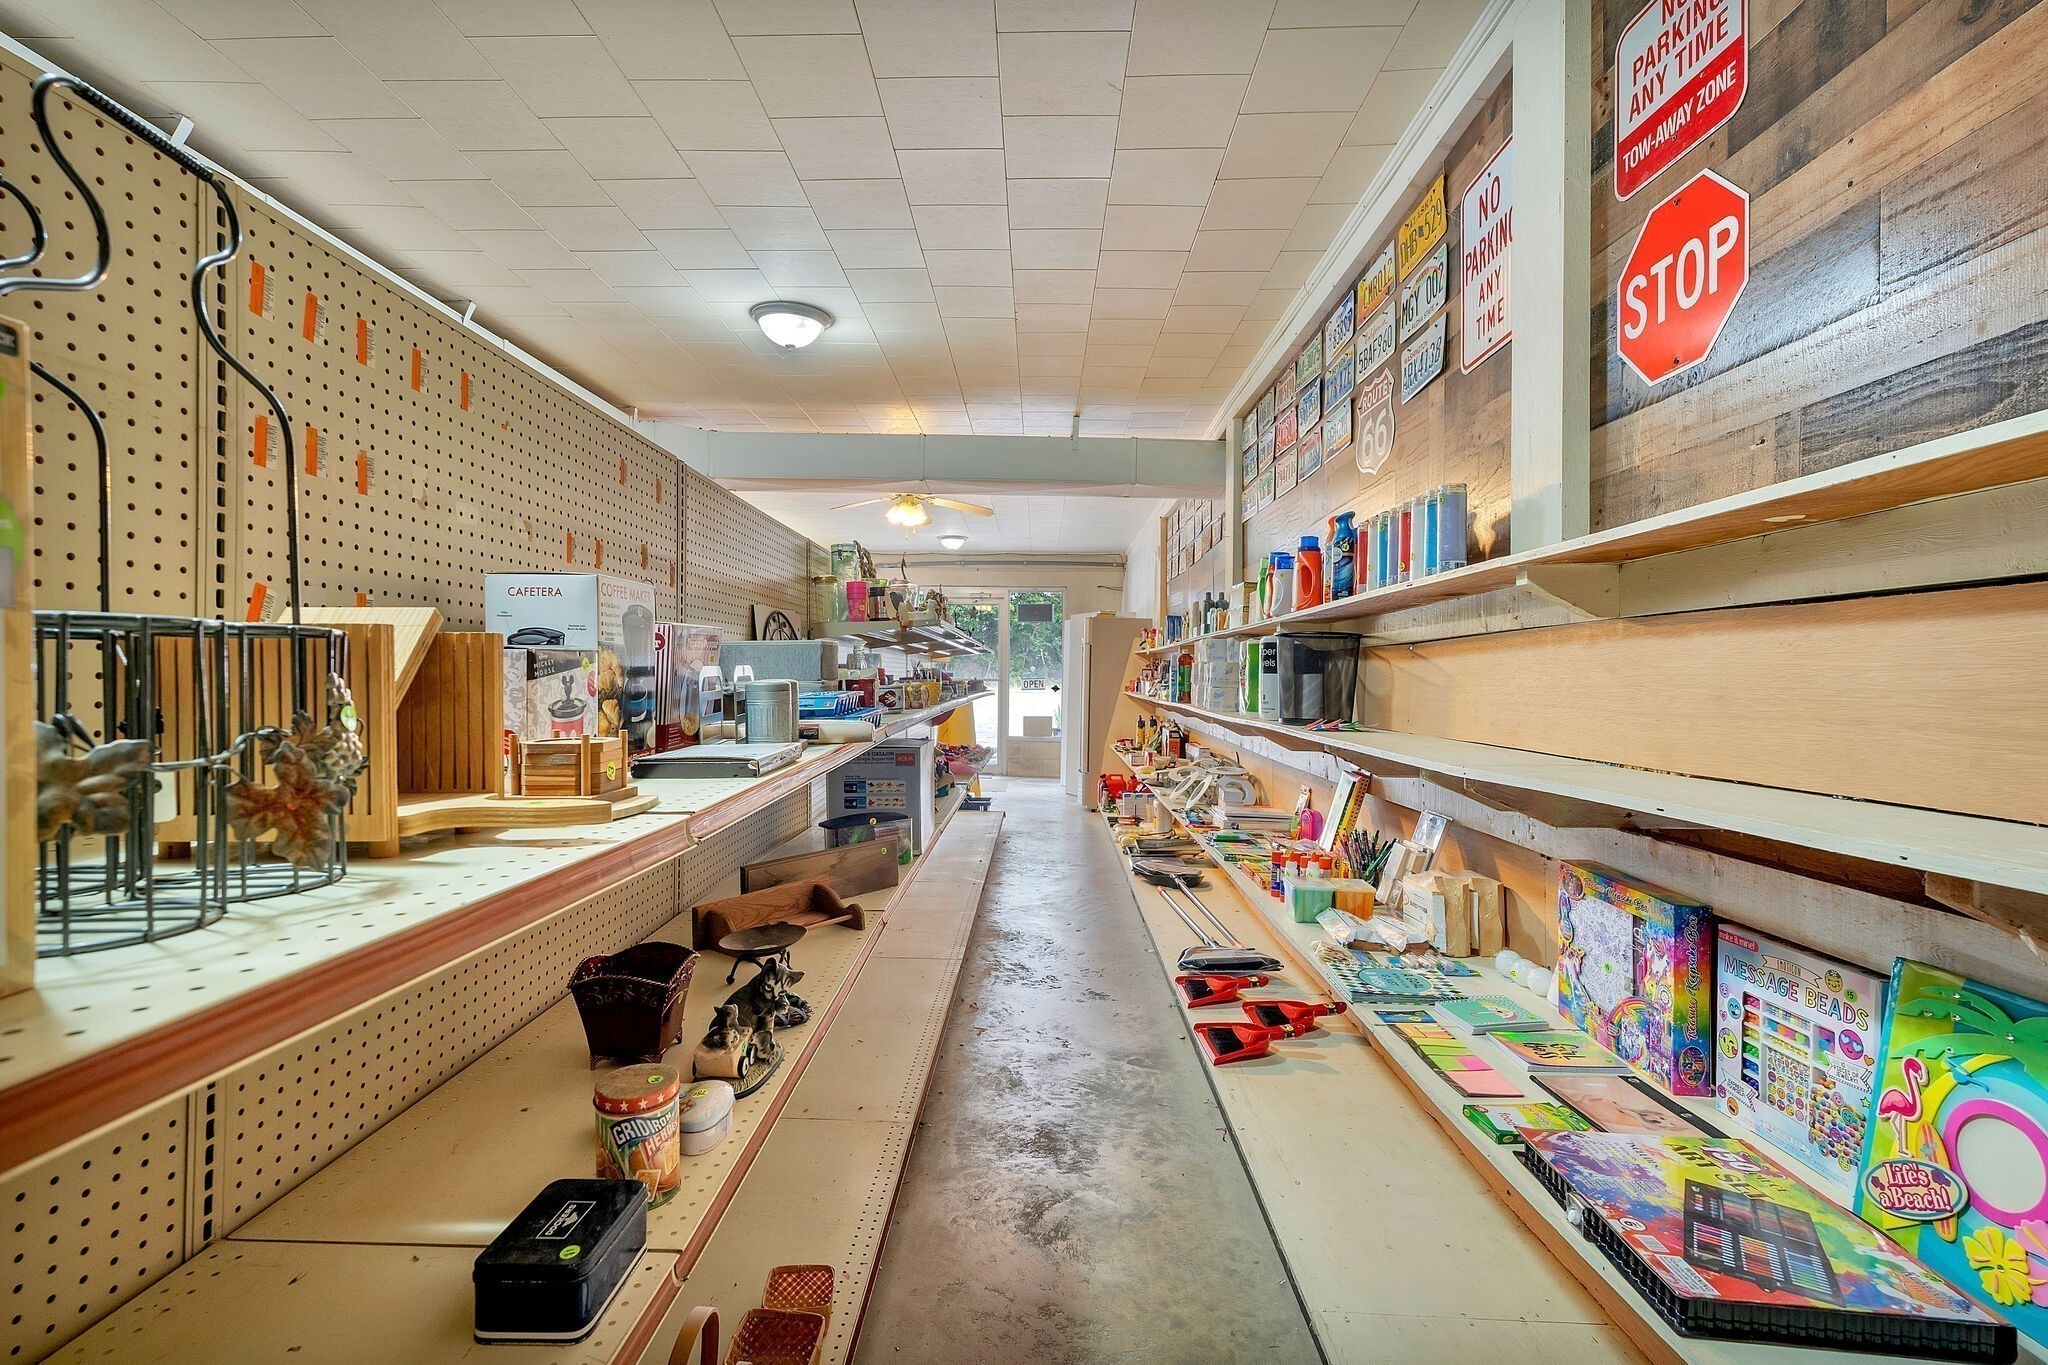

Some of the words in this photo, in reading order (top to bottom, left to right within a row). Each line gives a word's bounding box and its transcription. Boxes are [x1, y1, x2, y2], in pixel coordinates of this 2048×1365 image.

[1661, 0, 1689, 26] N
[1628, 63, 1668, 124] ANY
[1674, 6, 1729, 78] TIME
[1622, 97, 1694, 174] TOW-AWAY
[1696, 59, 1737, 115] ZONE
[1479, 175, 1501, 228] NO
[1400, 228, 1418, 269] DHB
[1424, 198, 1442, 241] 529
[1401, 285, 1420, 329] MGY
[1425, 261, 1444, 305] 002
[1479, 265, 1502, 307] ANY
[1624, 215, 1740, 340] STOP
[1476, 297, 1504, 340] TIME
[1358, 324, 1392, 374] 5BAF960
[1361, 379, 1388, 412] ROUTE
[1361, 408, 1387, 464] 66
[507, 586, 563, 597] CAFETERA
[601, 582, 628, 600] COFFEE
[533, 658, 555, 670] MICKEY
[1262, 648, 1276, 656] per
[534, 666, 556, 678] MOUSE
[1023, 679, 1045, 689] OPEN
[1684, 914, 1699, 948] Box
[1684, 954, 1702, 997] Keepsake
[1724, 954, 1799, 1003] MESSAGE
[1804, 986, 1869, 1031] BEADS
[1846, 990, 1855, 1000] $5
[1683, 997, 1699, 1043] Treasure
[612, 1111, 672, 1146] GRIDIRON
[1664, 1143, 1722, 1170] ART
[1714, 1173, 1776, 1201] SET
[1700, 1145, 1761, 1172] 150
[1883, 1162, 1930, 1188] Life's
[1888, 1185, 1954, 1213] Beach!
[545, 1204, 577, 1235] DOCKERS
